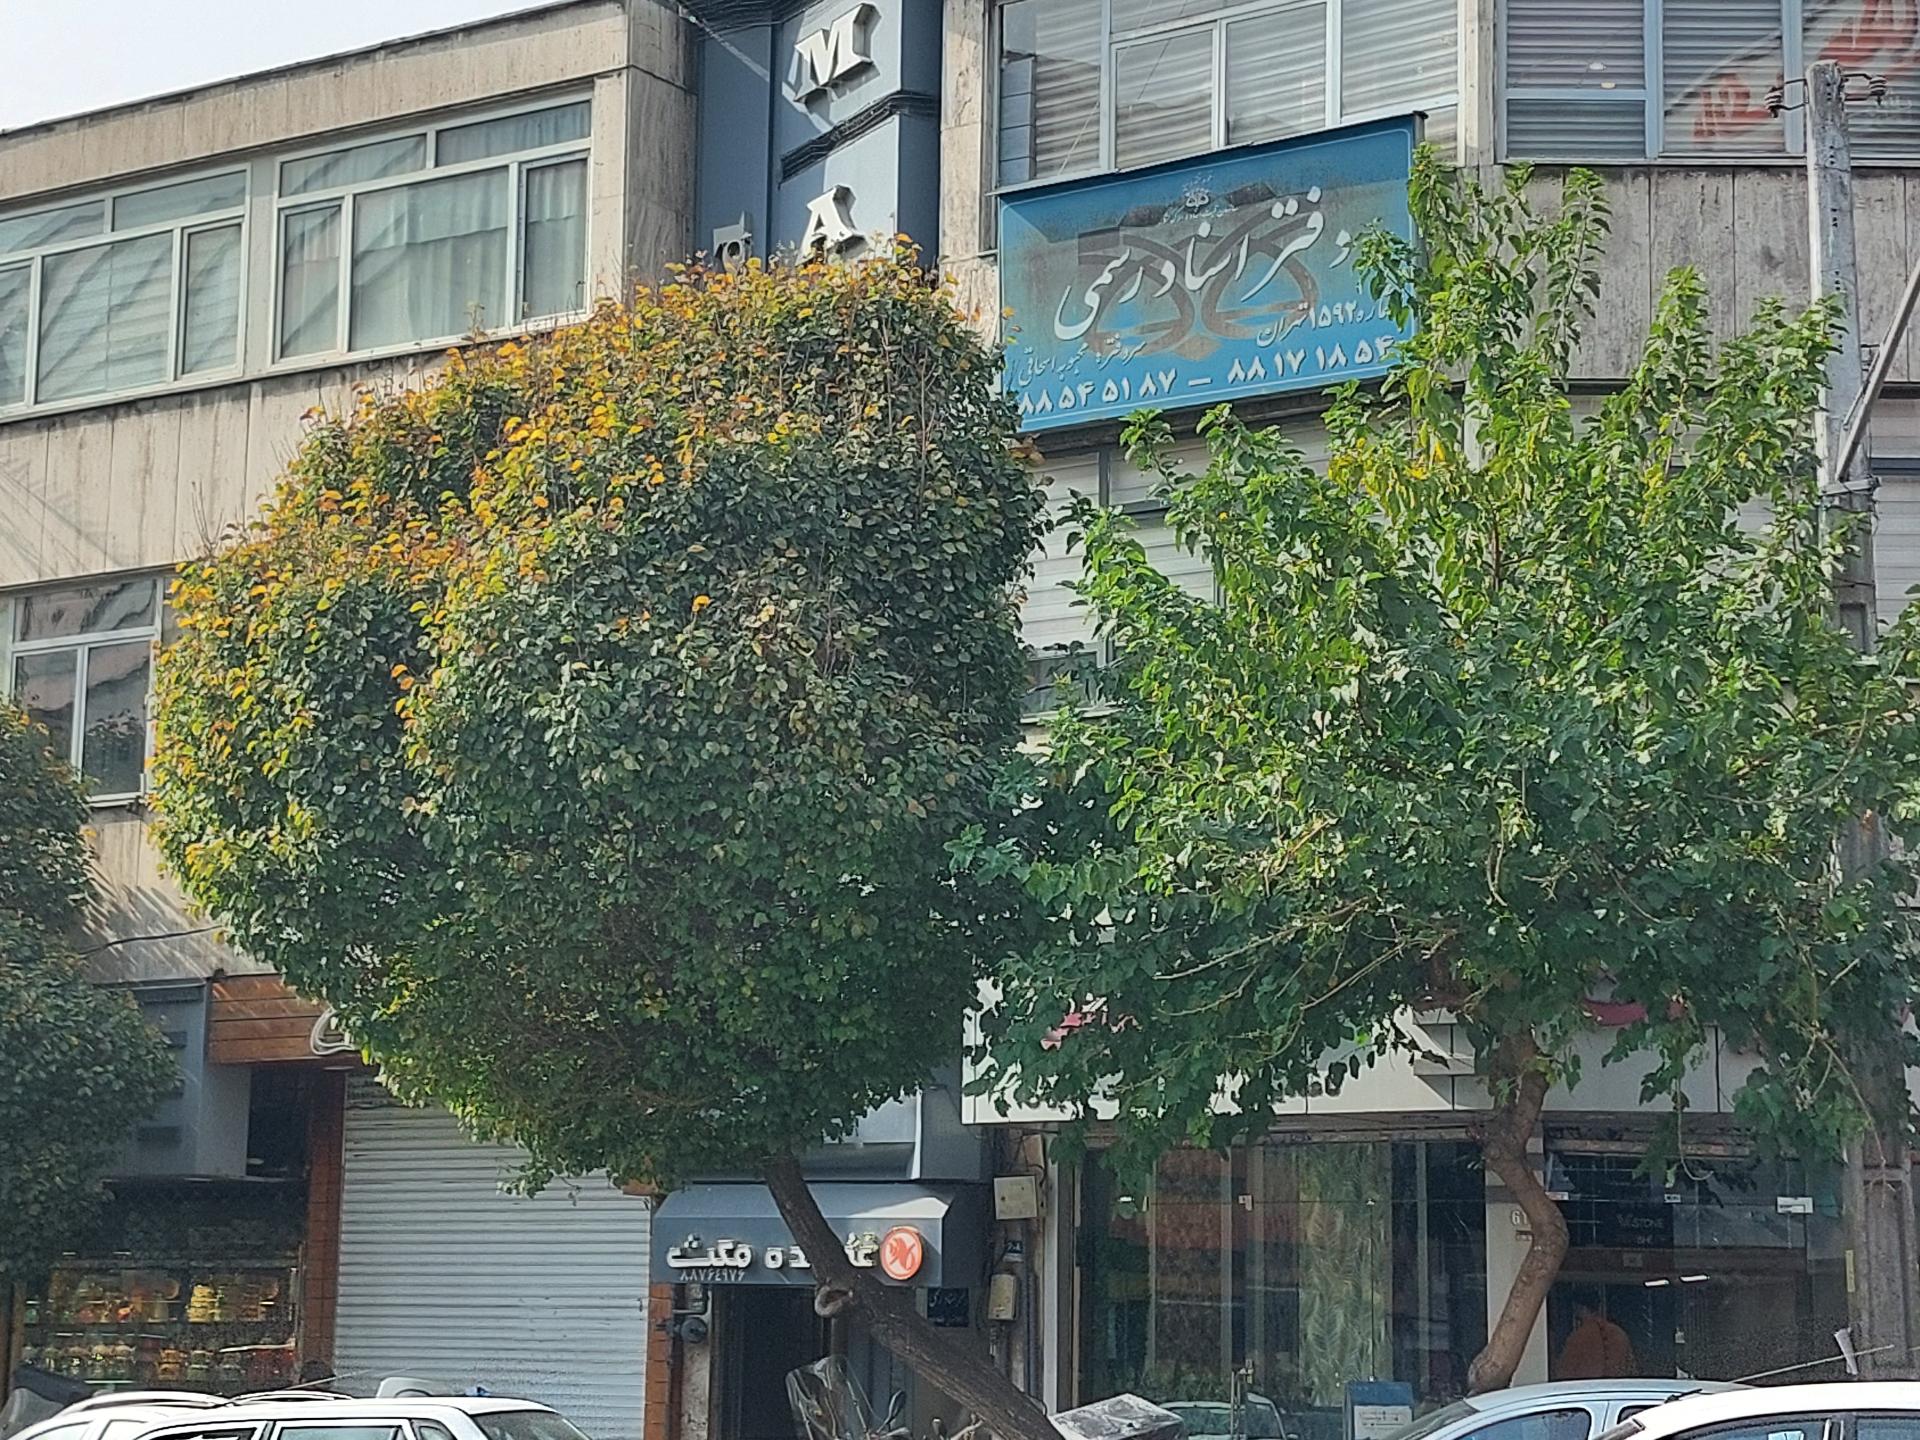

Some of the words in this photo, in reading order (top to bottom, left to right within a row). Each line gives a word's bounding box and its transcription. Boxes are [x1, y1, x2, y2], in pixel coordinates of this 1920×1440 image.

[1153, 221, 1249, 298] اسناد
[1241, 186, 1352, 301] دفتر
[1054, 249, 1143, 340] رسمی
[1257, 302, 1309, 347] تهران
[667, 1233, 752, 1268] مکث
